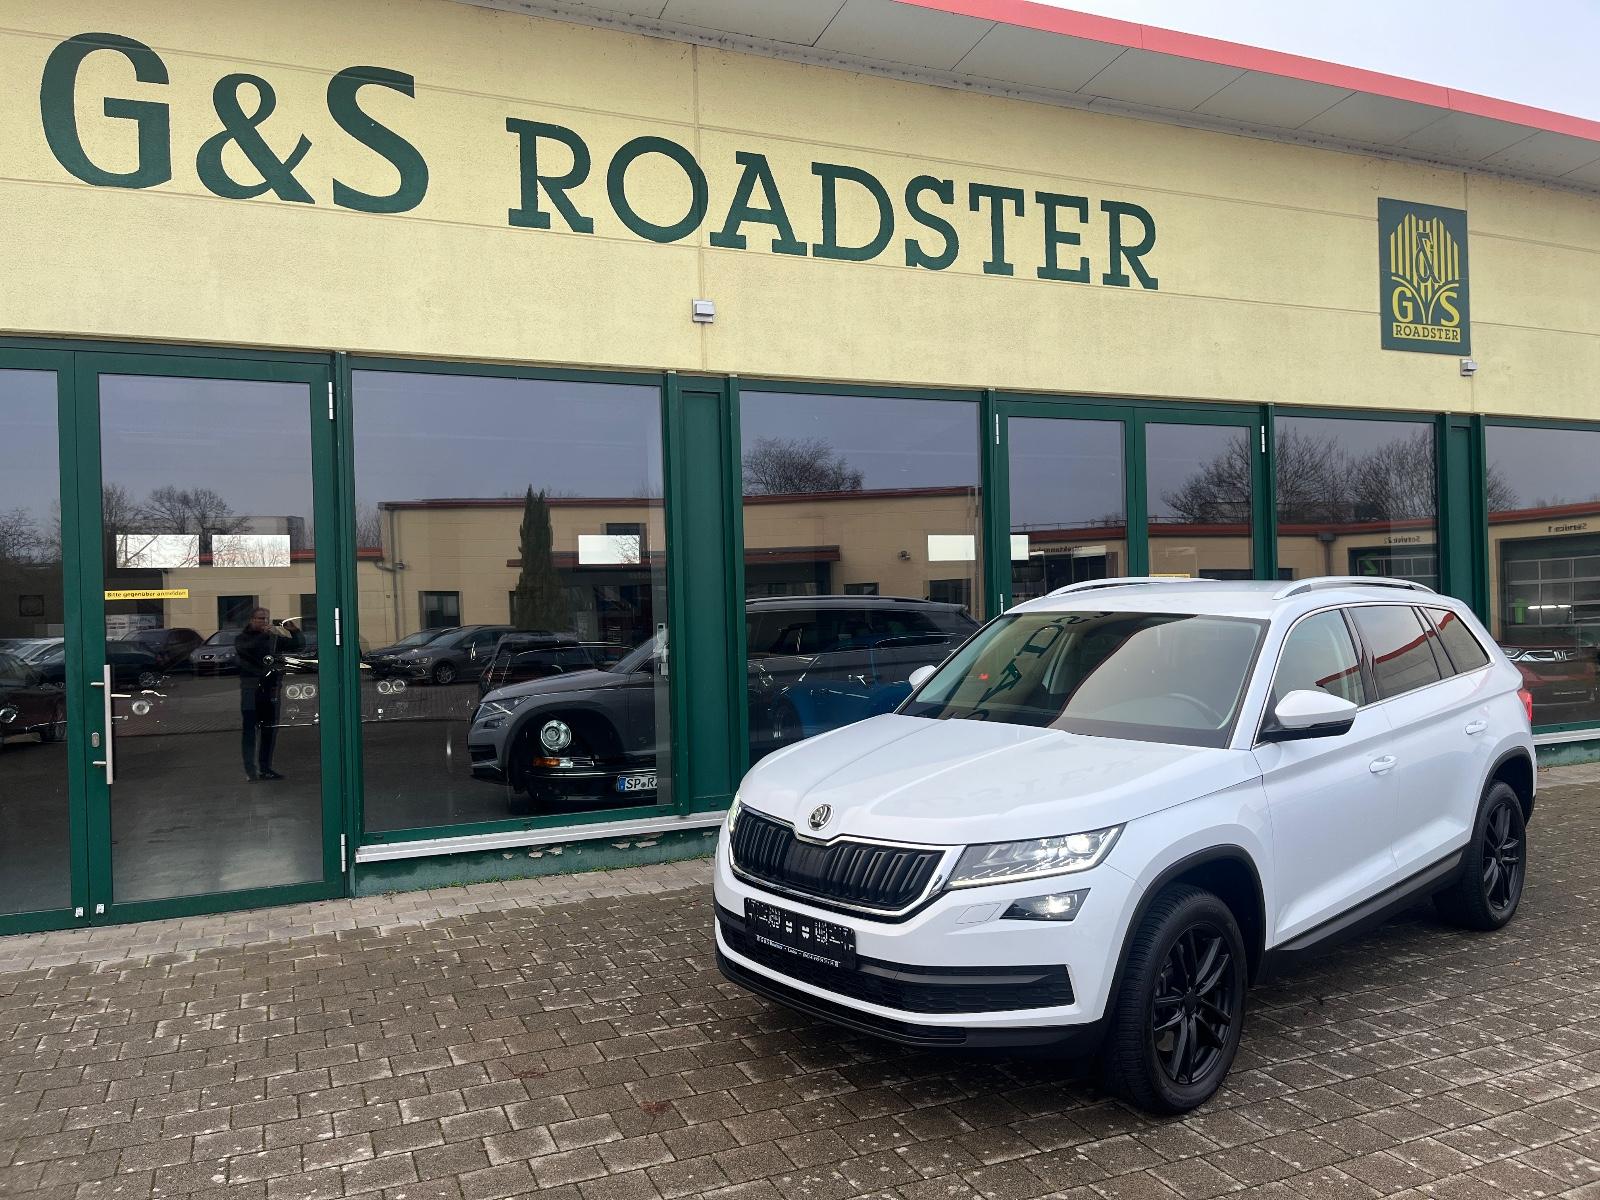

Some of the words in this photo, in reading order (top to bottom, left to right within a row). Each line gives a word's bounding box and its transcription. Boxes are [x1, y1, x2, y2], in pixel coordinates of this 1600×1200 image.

[40, 32, 429, 213] G&S
[506, 117, 1158, 289] ROADSTER
[1395, 324, 1459, 341] ROADSTER
[626, 778, 641, 789] SP
